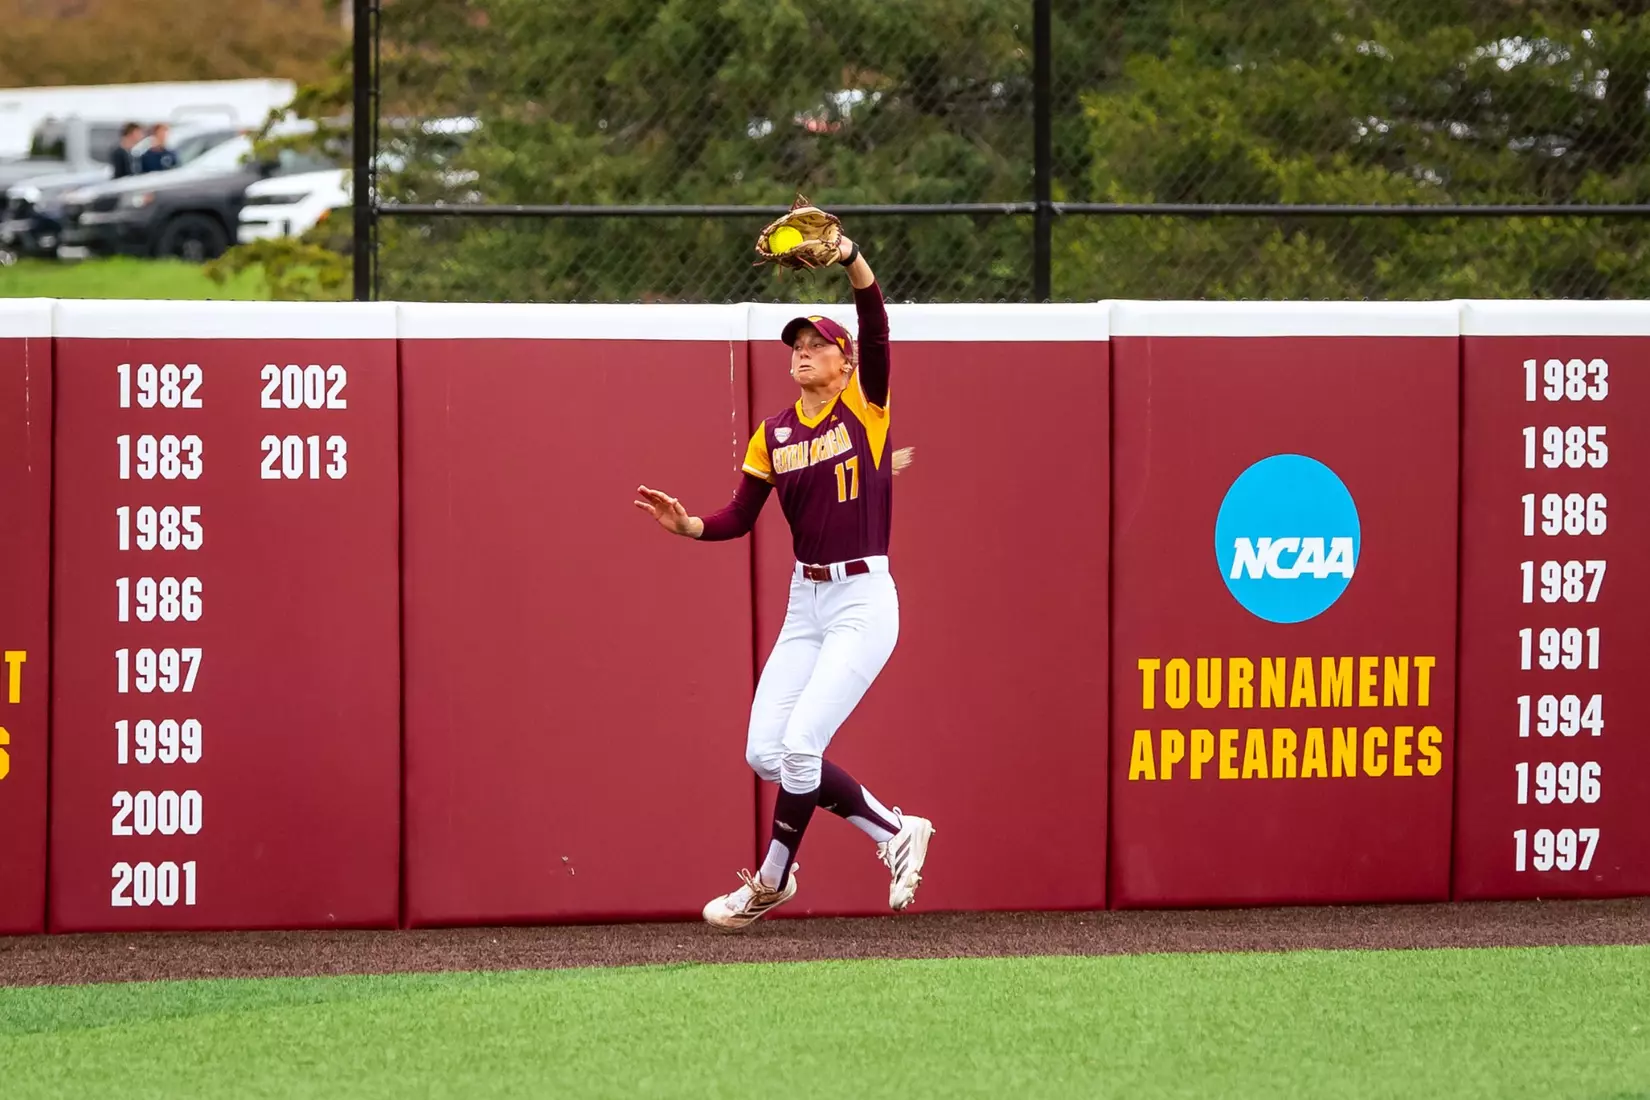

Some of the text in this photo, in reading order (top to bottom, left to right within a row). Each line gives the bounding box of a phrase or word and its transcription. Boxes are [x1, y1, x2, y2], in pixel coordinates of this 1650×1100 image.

[116, 363, 203, 409] 1982
[260, 363, 348, 410] 2002
[1522, 358, 1609, 402] 1983
[116, 434, 203, 480] 1983
[260, 434, 348, 480] 2013
[1522, 425, 1609, 469] 1985
[834, 455, 859, 503] 17
[116, 505, 203, 551] 1985
[1521, 492, 1608, 537] 1986
[1229, 537, 1355, 579] NCAA
[115, 576, 203, 623] 1986
[1520, 559, 1607, 604] 1987
[115, 647, 203, 694] 1997
[1518, 626, 1600, 671] 1991
[1137, 656, 1436, 710] TOURNAMENT
[1516, 693, 1605, 738] 1994
[114, 718, 203, 765] 1999
[1128, 725, 1443, 781] APPEARANCES
[1515, 761, 1602, 805] 1996
[111, 789, 203, 836] 2000
[1513, 827, 1600, 872] 1997
[111, 860, 197, 907] 2001
